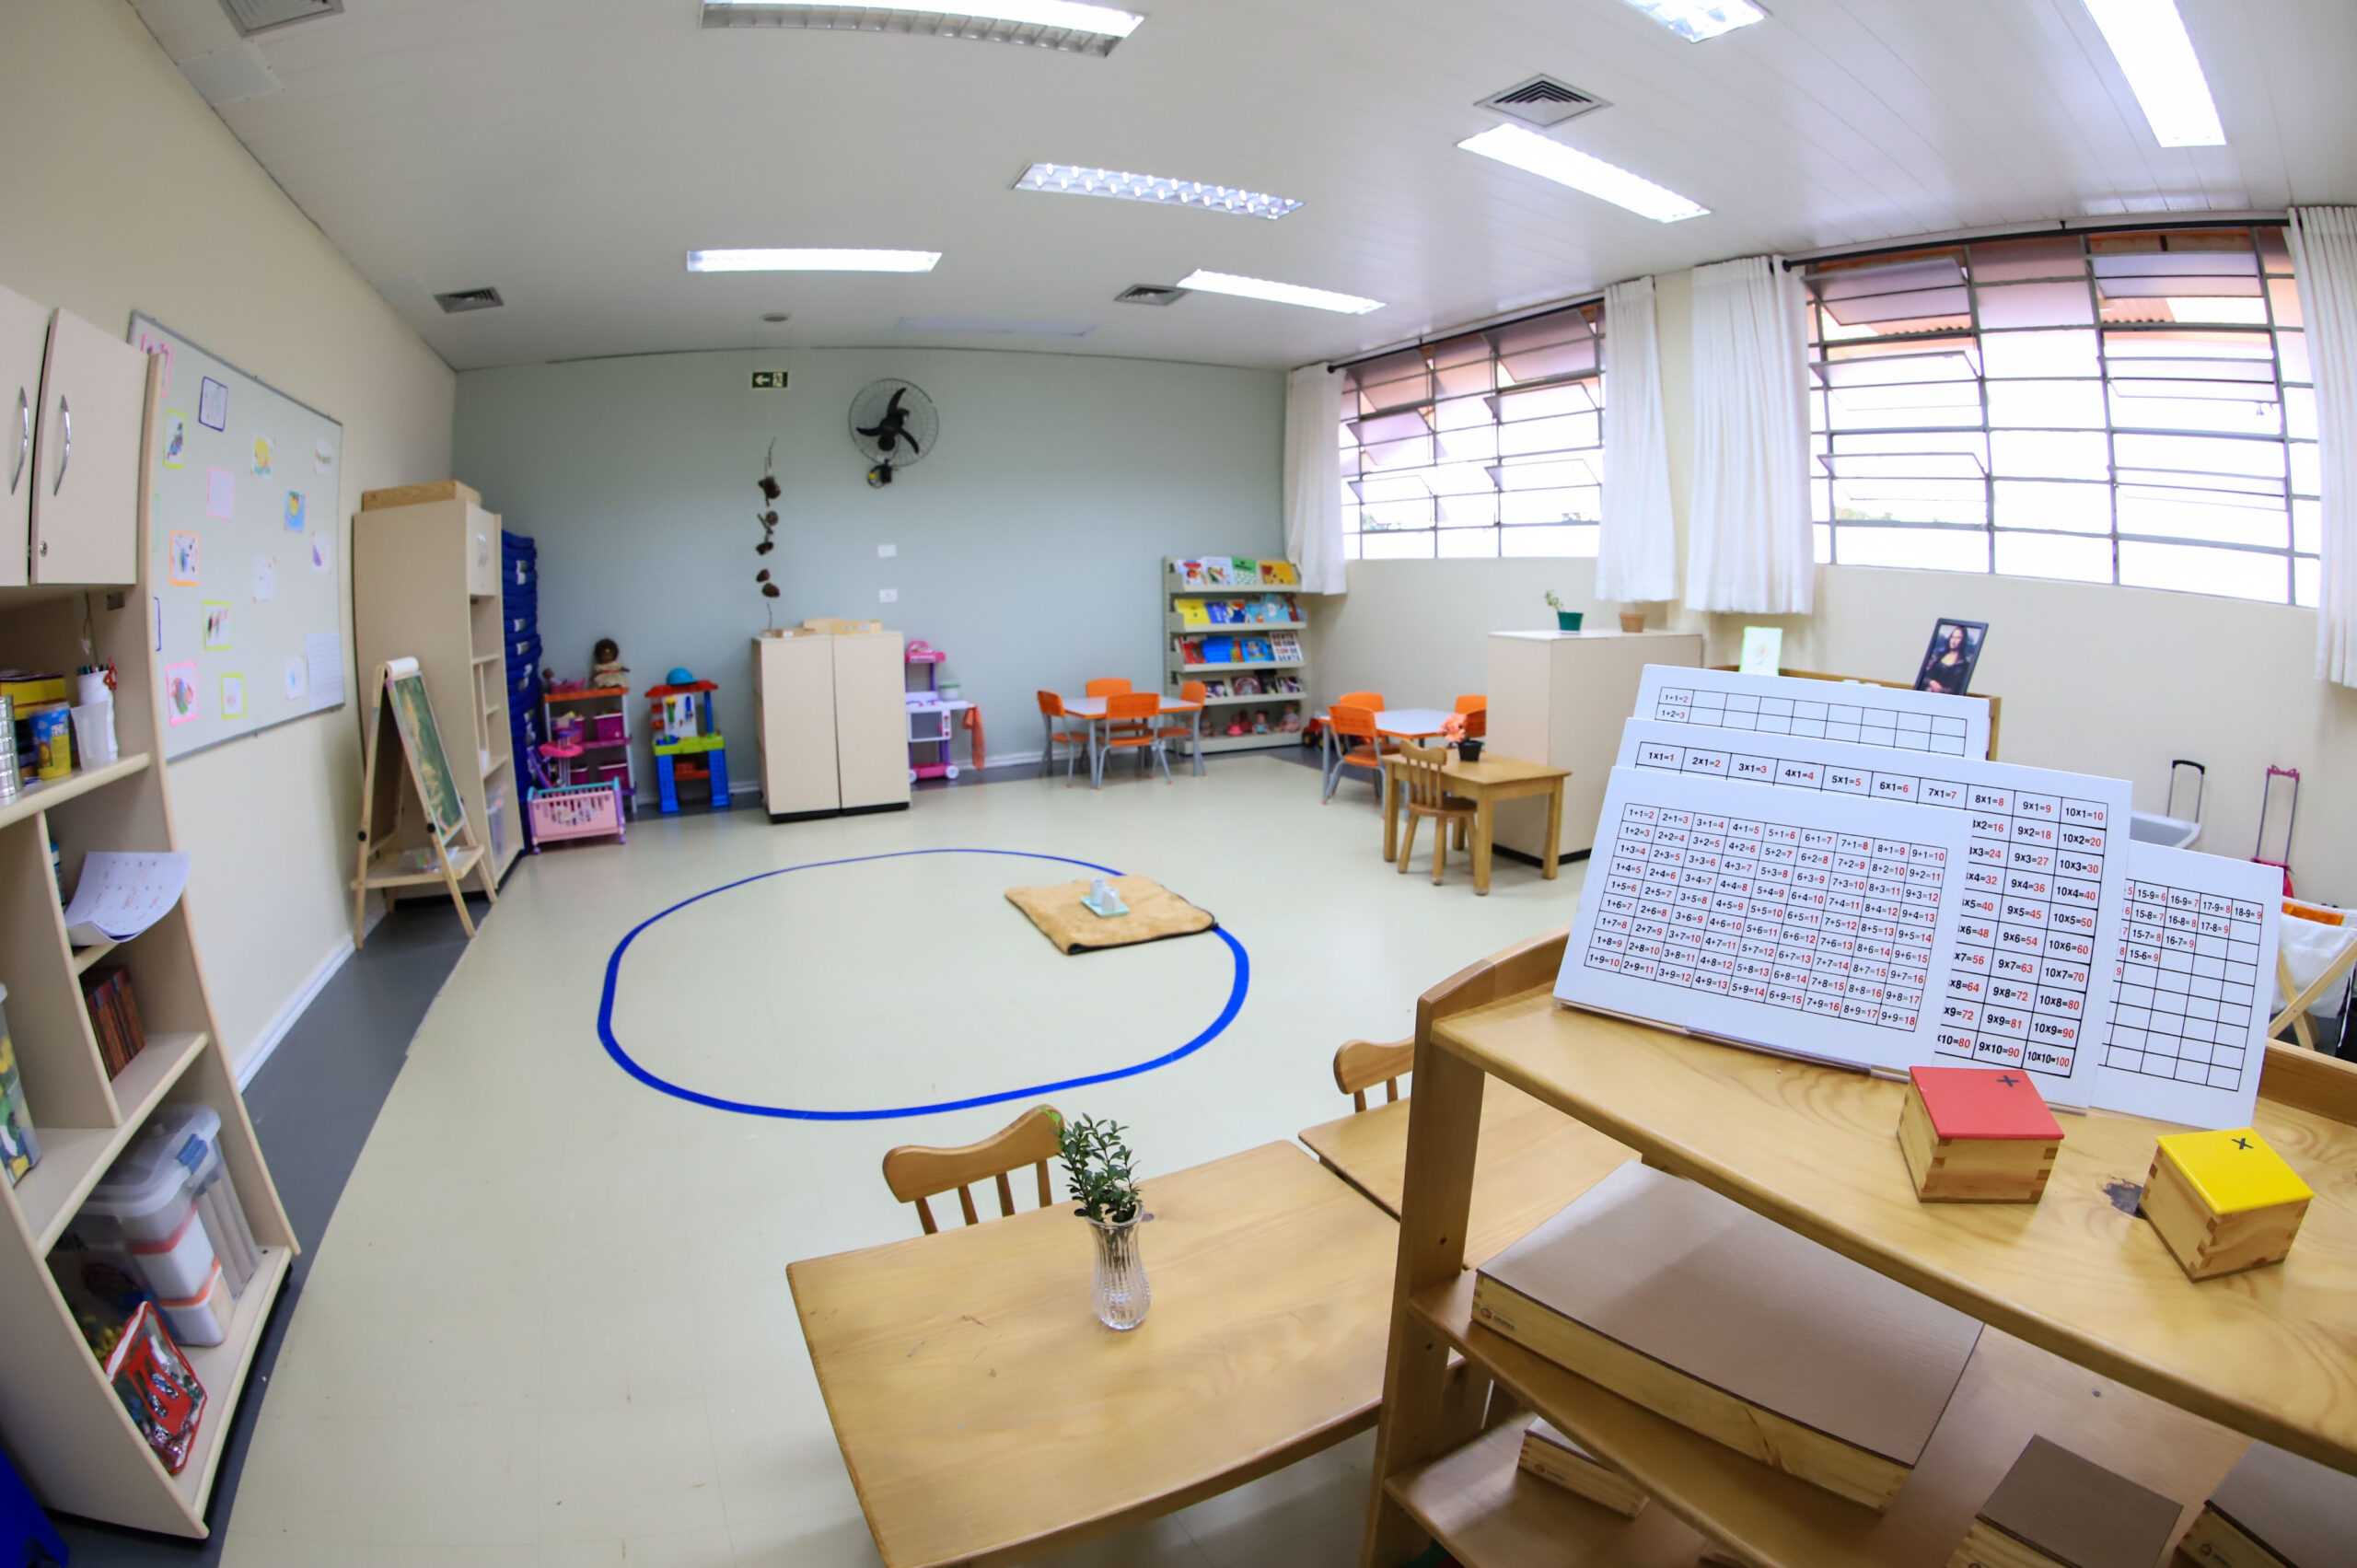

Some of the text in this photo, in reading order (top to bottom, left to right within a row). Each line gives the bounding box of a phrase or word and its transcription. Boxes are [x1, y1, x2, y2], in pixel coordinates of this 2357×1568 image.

[1665, 694, 1689, 703] 1+1=2
[1625, 826, 1941, 881] 1+2=3 2+2=4 3+2=5 4+2=6 5+2=7 6+2=8 7+2=9 8+2=10 9+2=11
[1630, 808, 1945, 862] 1+1=2 2+1=3 3+1=4 4+1=5 5+1=6 6+1=7 7+1=8 8+1=9 9+1=10
[1617, 863, 1935, 923] 1+4=5 2+4=6 3+4=7 4+4=8 5+4=9 6+4=10 7+4=11 8+4=12 9+4=13
[1620, 844, 1939, 902] 1+3=4 2+3=5 3+3=6 4+3=7 5+3=8 6+3=9 7+3=10 8+3=11 9+3=12
[1966, 872, 1998, 886] x4=32
[1608, 899, 1928, 963] 1+6=7 2+6=8 3+6=9 4+6=10 5+6=11 6+6=12 7+6=13 8+6=14 9+6=15
[1612, 880, 1932, 943] 1+5=6 2+5=7 3+5=8 4+5=9 5+5=10 6+5=11 7+5=12 8+5=13 9+5=14
[1957, 924, 1990, 938] x6=48
[1961, 899, 1993, 912] x5=40
[1597, 935, 1921, 1005] 1+8=9 2+8=10 3+8=11 4+8=12 5+8=13 6+8=14 7+8=15 8+8=16 9+8=17
[1602, 917, 1924, 984] 1+7=8 2+7=9 3+7=10 4+7=11 5+7=12 6+7=13 7+7=14 8+7=15 9+7=16
[1590, 954, 1915, 1026] 1+9=10 2+9=11 3+9=12 4+9=13 5+9=14 6+9=15 7+9=16 8+9=17 9+9=18
